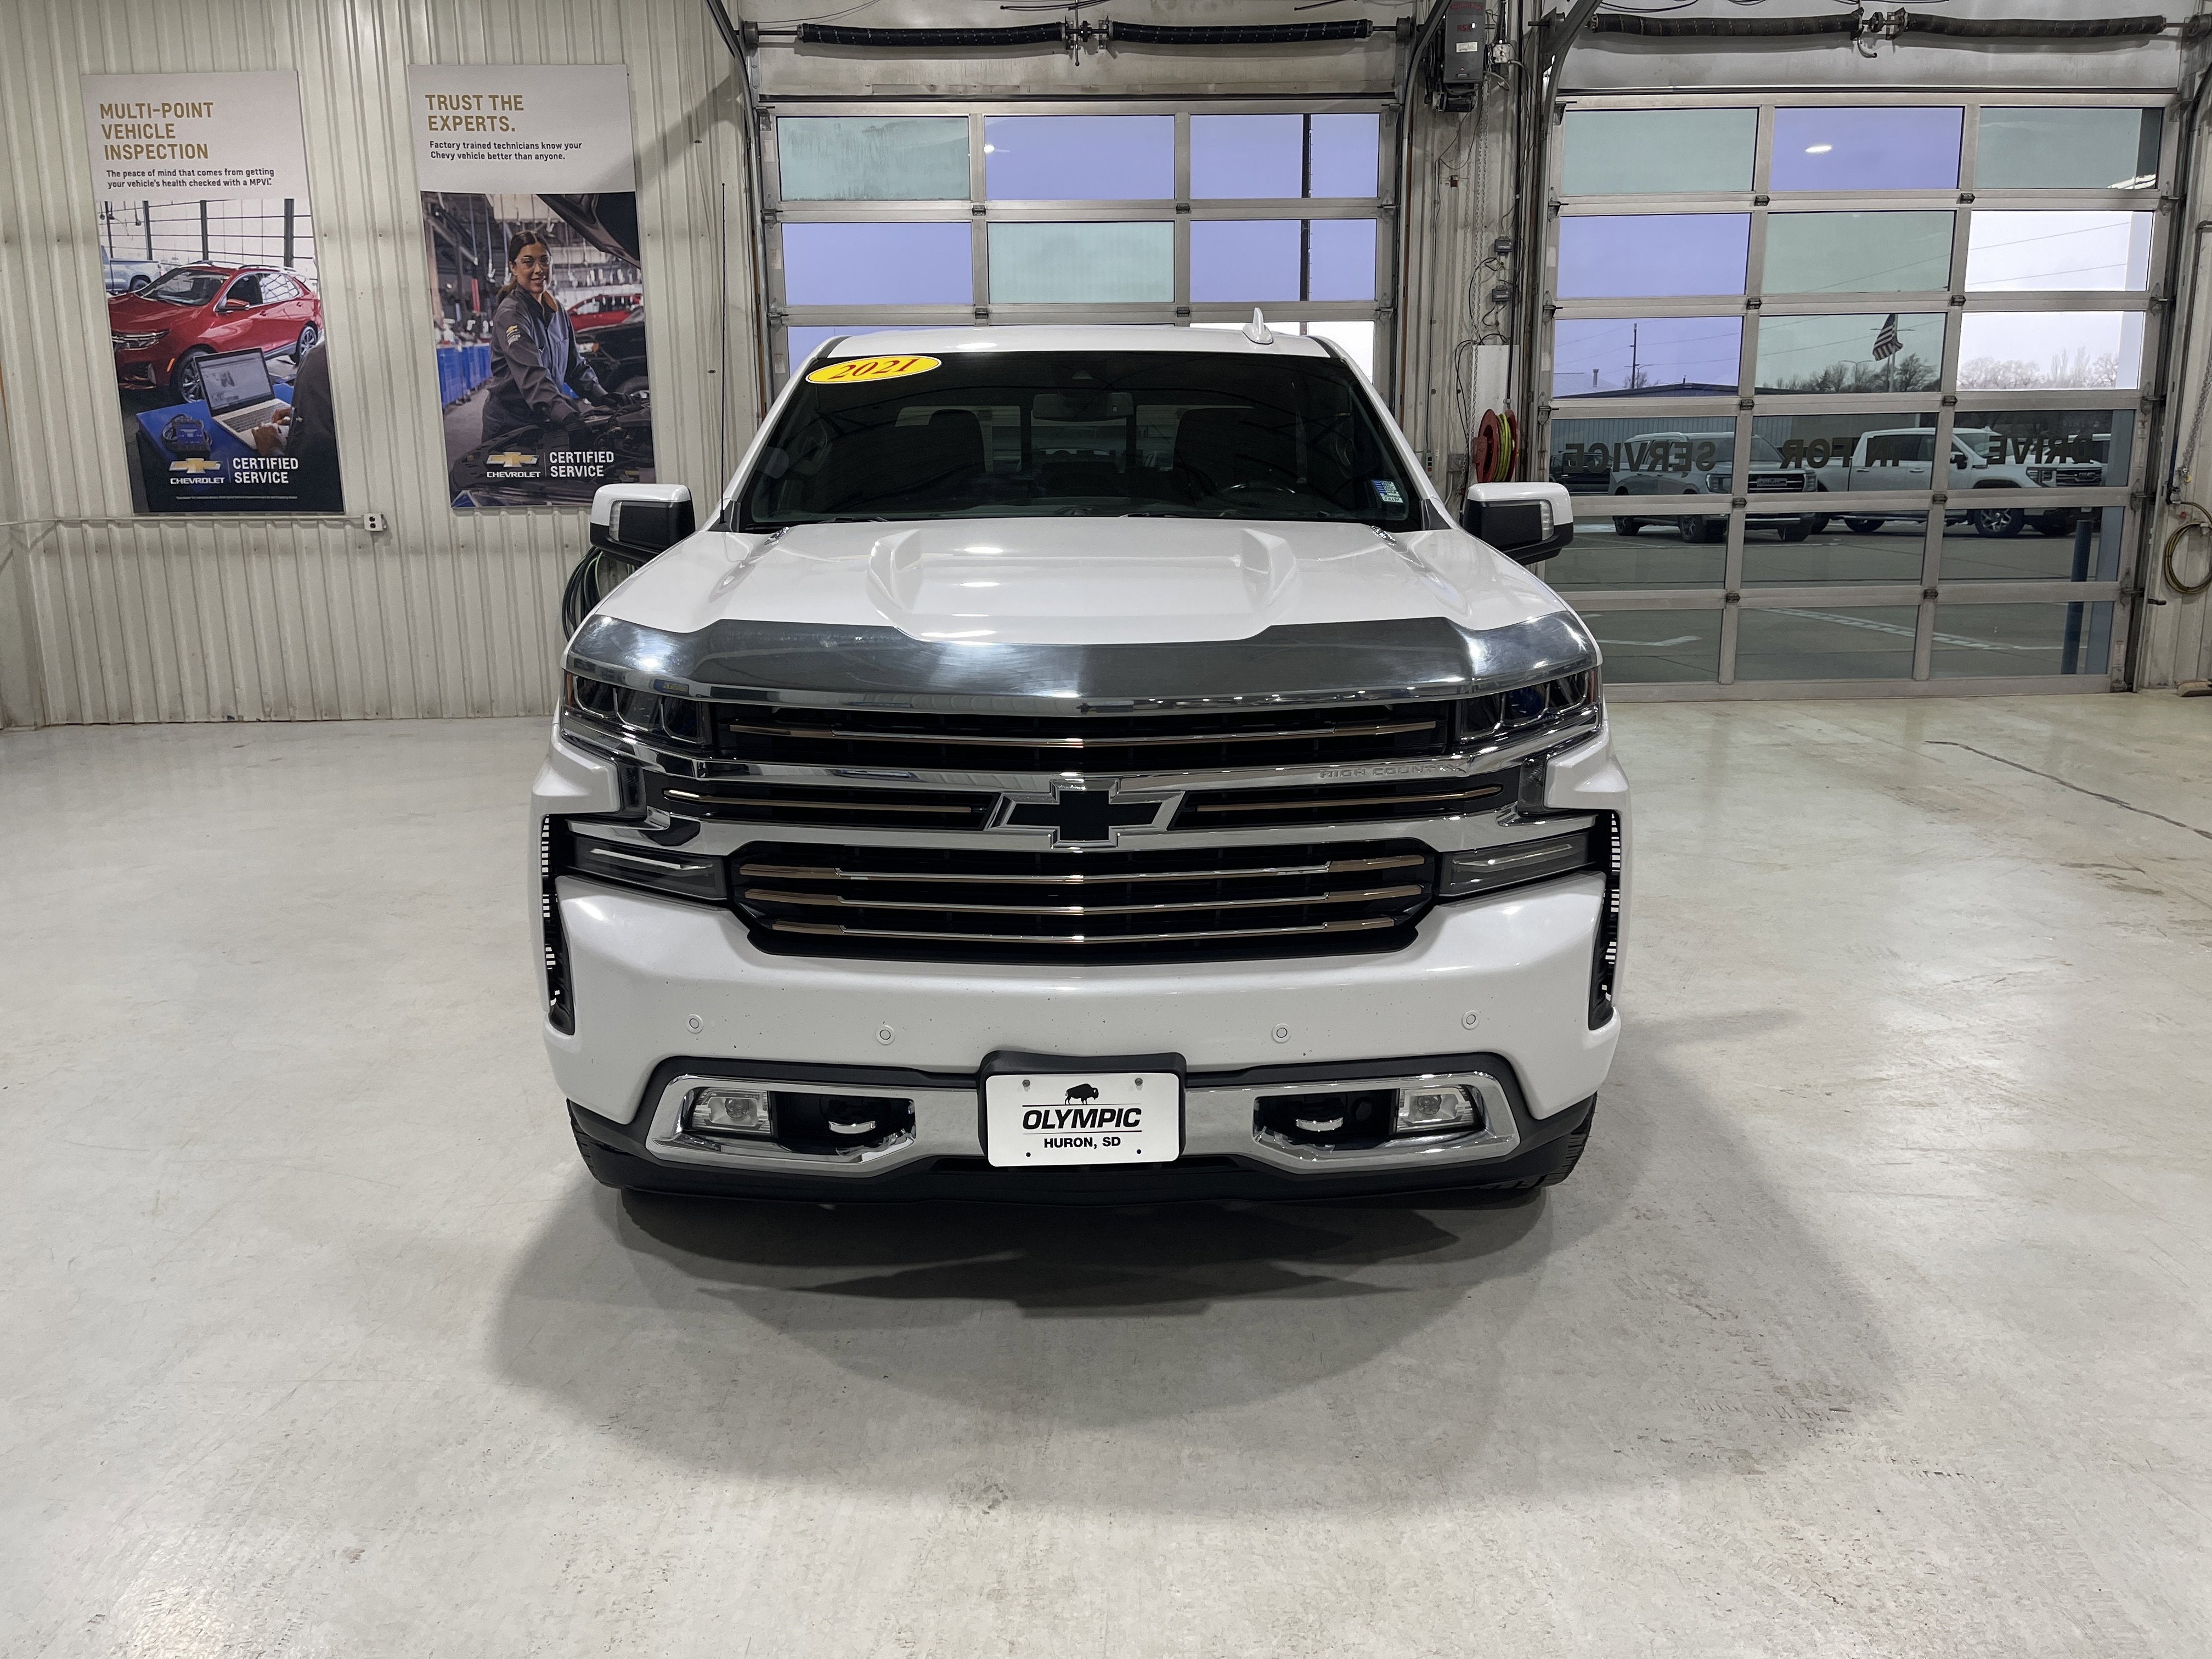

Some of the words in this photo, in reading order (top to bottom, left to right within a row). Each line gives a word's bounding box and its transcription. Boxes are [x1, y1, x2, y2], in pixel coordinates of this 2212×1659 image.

[425, 94, 483, 111] TRUST
[488, 94, 524, 111] THE
[100, 102, 213, 119] MULTI-POINT
[428, 115, 516, 132] EXPERTS.
[101, 123, 176, 139] VEHICLE
[430, 140, 460, 150] Factory
[565, 143, 582, 151] your
[104, 144, 208, 160] INSPECTION
[431, 151, 455, 161] Chevy
[457, 151, 485, 160] vehicle
[123, 171, 145, 179] peace
[224, 168, 243, 176] from
[246, 167, 274, 177] getting
[108, 181, 125, 189] your
[127, 179, 160, 188] vehicle's
[162, 179, 187, 187] health
[189, 178, 221, 187] checked
[827, 358, 919, 380] 2021
[233, 458, 298, 470] CERTIFIED
[549, 452, 614, 464] CERTIFIED
[550, 465, 604, 477] SERVICE
[170, 477, 225, 485] CHEVROLET
[234, 472, 289, 484] SERVICE
[1320, 768, 1365, 778] HIGH
[1022, 1108, 1142, 1130] OLYMPIC
[1044, 1137, 1097, 1150] HURON,
[1102, 1137, 1121, 1147] SD
